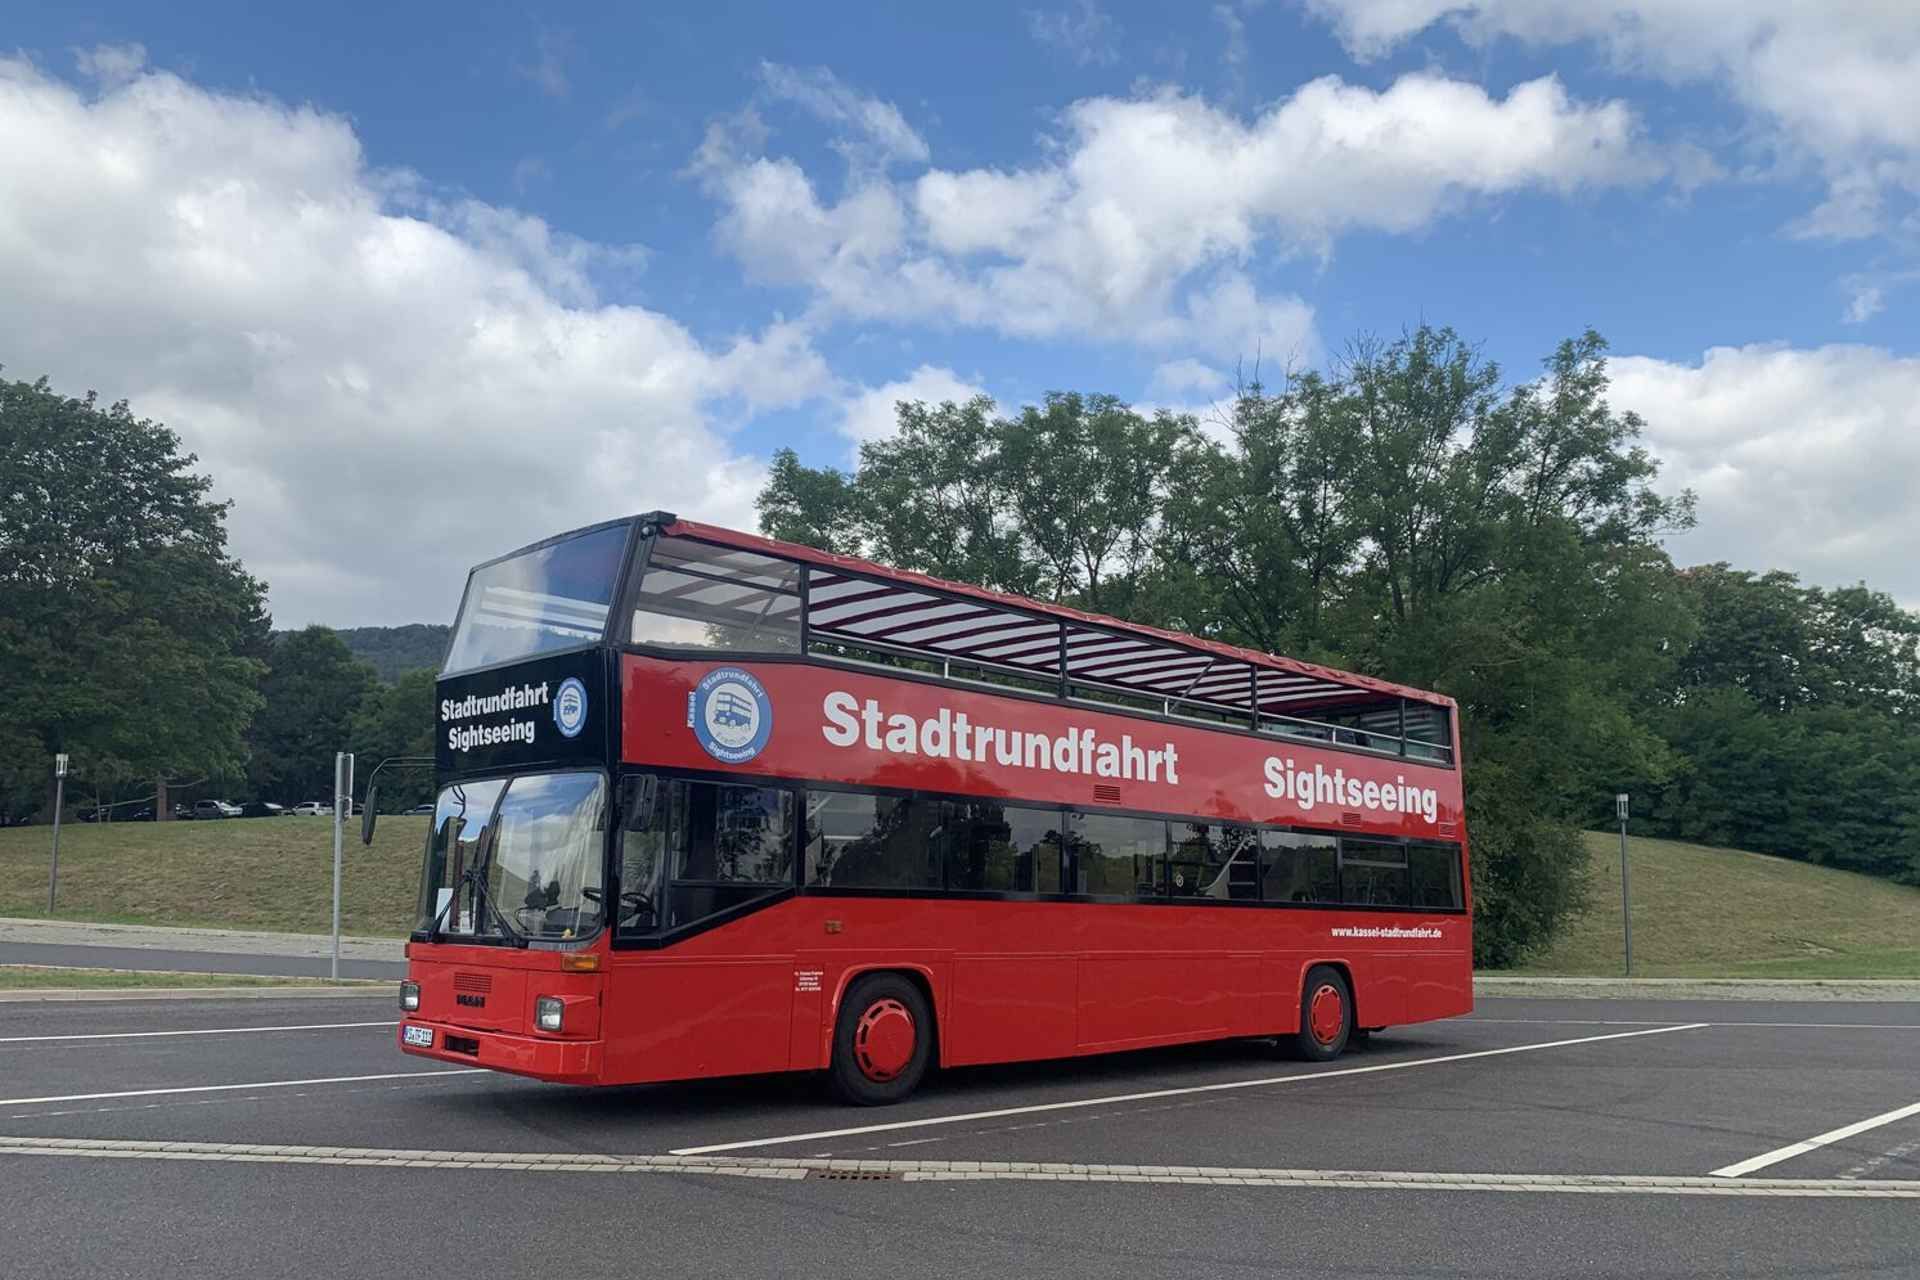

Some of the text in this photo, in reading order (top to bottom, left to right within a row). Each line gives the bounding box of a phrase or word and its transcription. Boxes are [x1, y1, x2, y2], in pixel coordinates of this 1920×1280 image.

[441, 681, 549, 722] Stadtrundfahrt
[702, 671, 763, 697] Stadtrundfahrt
[448, 717, 535, 753] Sightseeing
[708, 740, 756, 761] Sightseeing
[822, 690, 1179, 785] Stadtrundfahrt
[1263, 756, 1438, 824] Sightseeing
[1331, 926, 1443, 938] www.kassel-stadtrundfahrt.de
